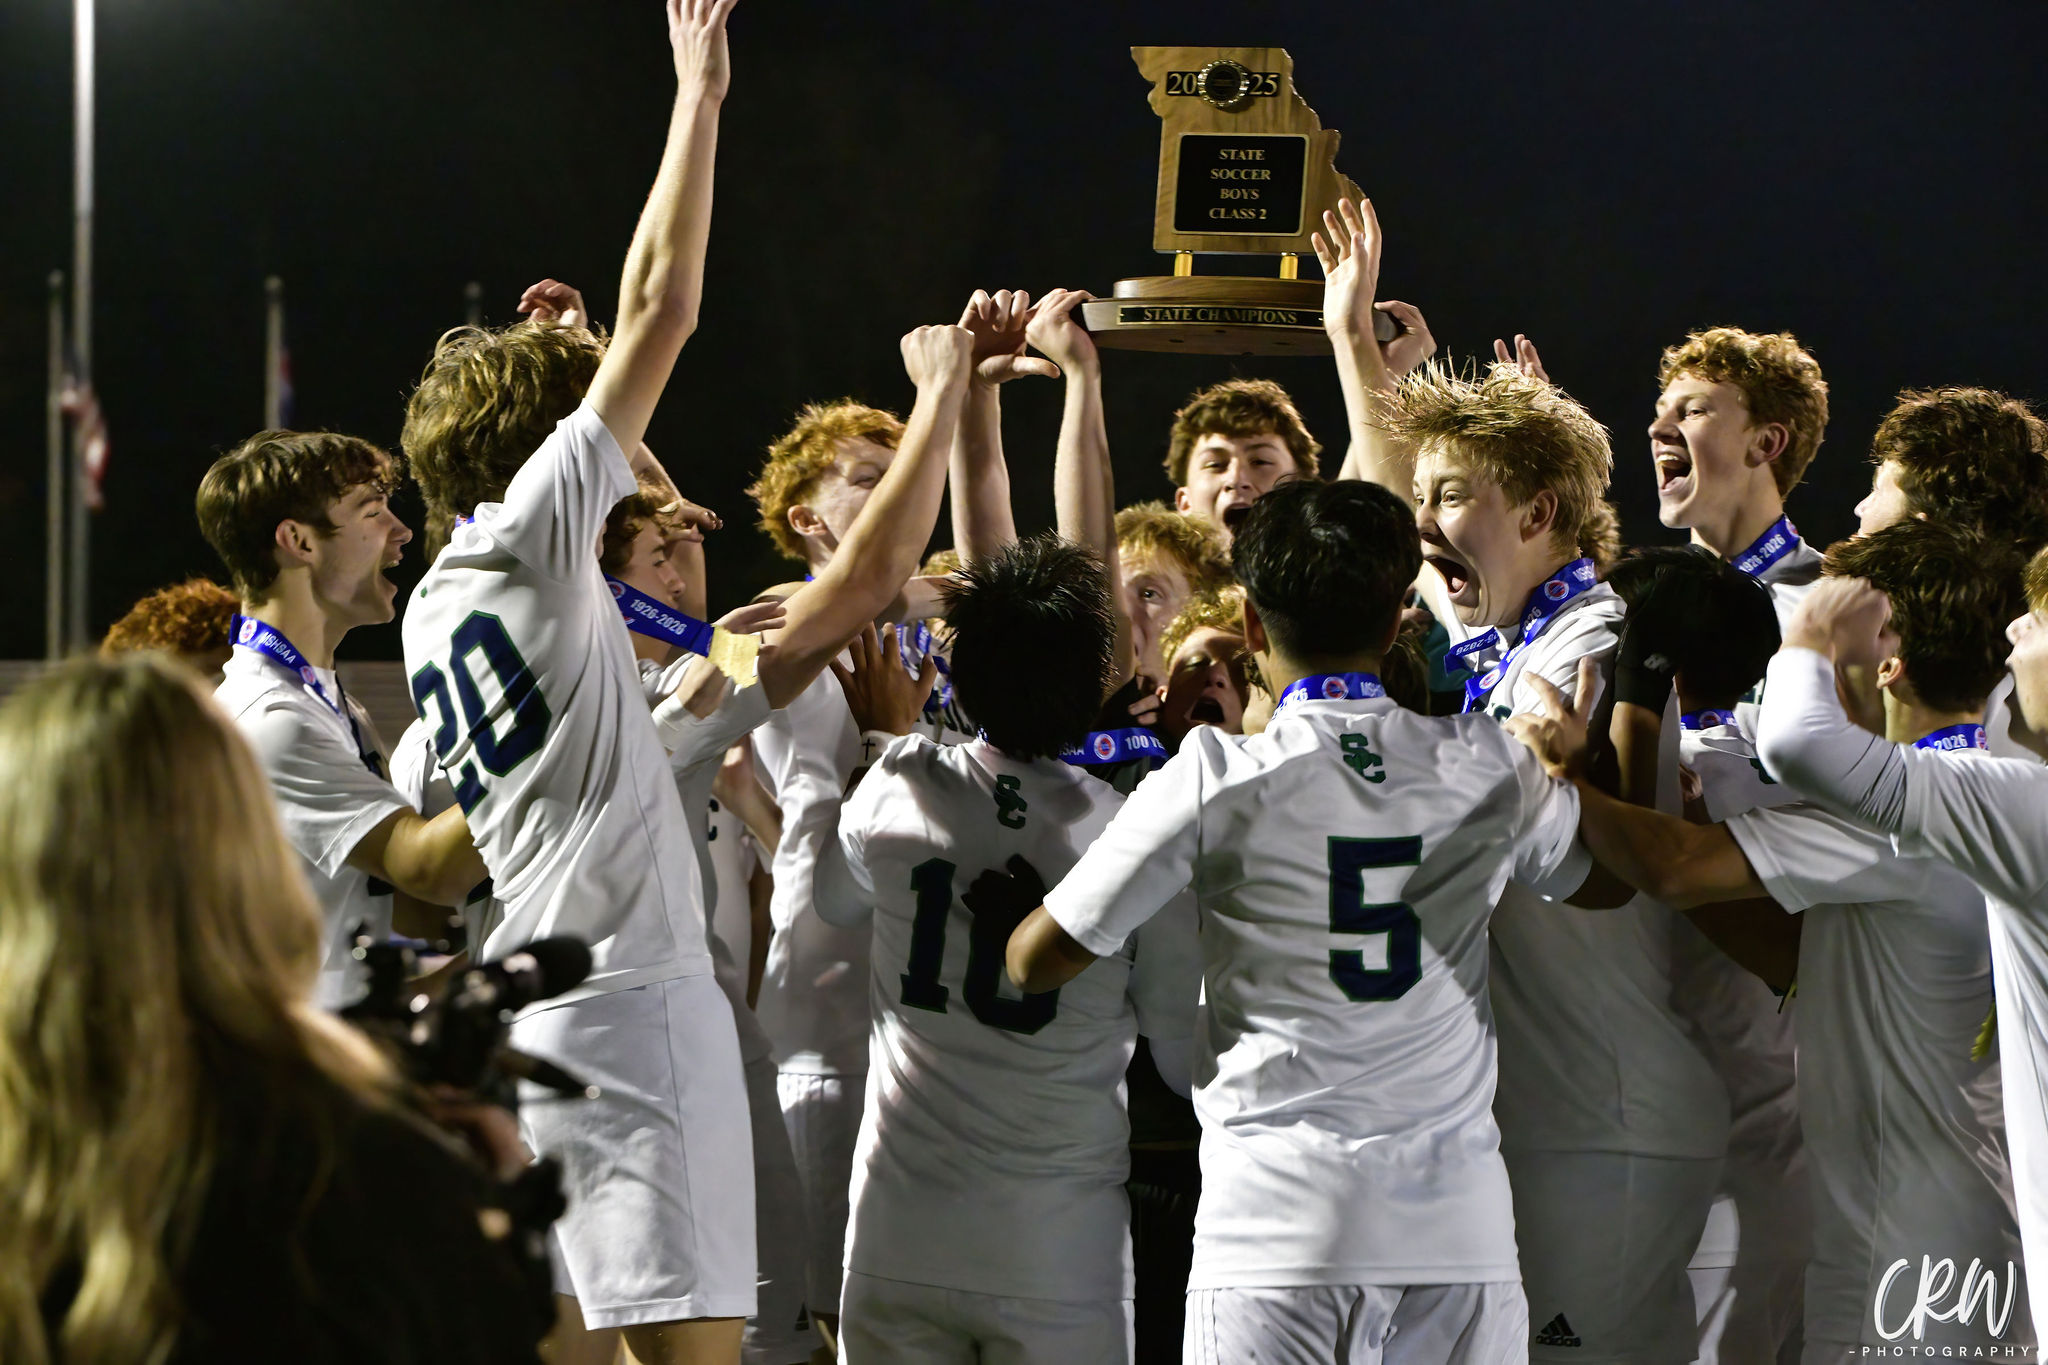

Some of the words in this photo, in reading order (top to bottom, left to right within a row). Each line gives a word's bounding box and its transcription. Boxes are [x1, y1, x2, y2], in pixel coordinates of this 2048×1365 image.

[1168, 73, 1198, 95] 20
[1249, 73, 1279, 95] 25
[1219, 149, 1265, 160] STATE
[1210, 168, 1271, 180] SOCCER
[1220, 188, 1260, 200] BOYS
[1209, 208, 1256, 219] CLASS
[1259, 208, 1267, 219] 2
[1143, 307, 1193, 321] STATE
[1196, 308, 1298, 324] CHAMPIONS
[630, 599, 688, 635] 1926-2026
[258, 631, 297, 664] MSHSAA
[412, 610, 552, 818] 20
[1125, 735, 1149, 750] 100
[1327, 835, 1423, 1002] 5
[1535, 1335, 1582, 1348] adidas
